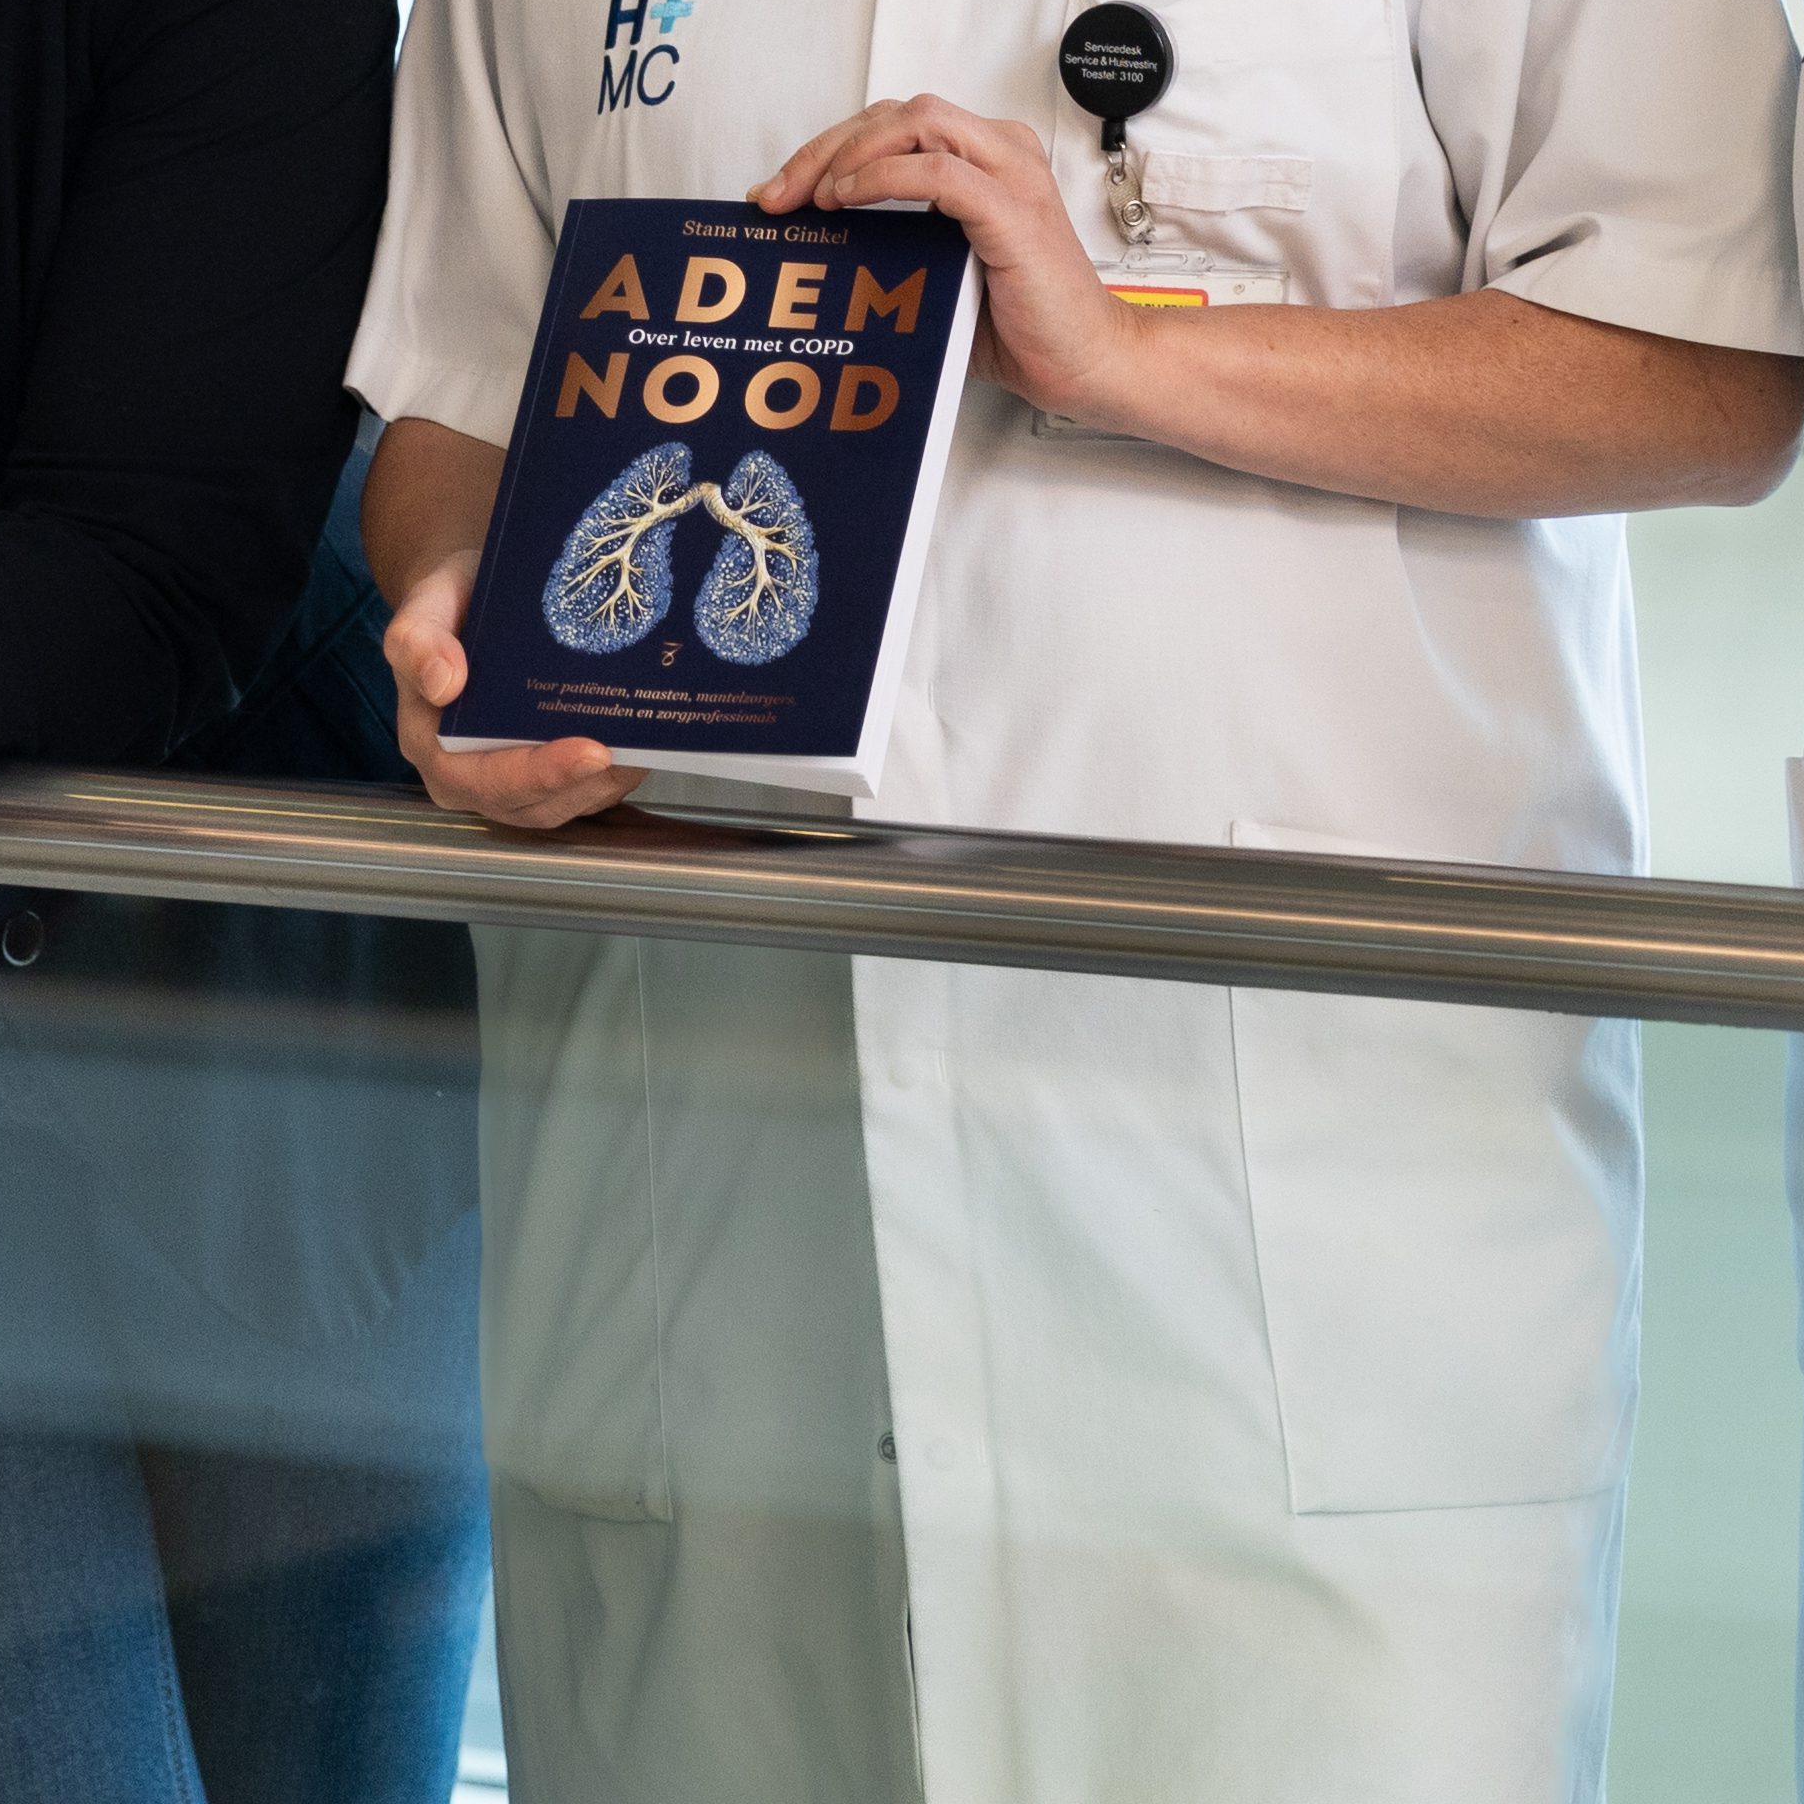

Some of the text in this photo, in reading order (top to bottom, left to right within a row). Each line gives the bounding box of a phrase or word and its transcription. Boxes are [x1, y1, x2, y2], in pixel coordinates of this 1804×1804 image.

[1065, 54, 1099, 65] Service
[1100, 56, 1107, 66] &
[1084, 41, 1142, 56] Servicedesk
[598, 44, 680, 115] MC
[1119, 71, 1144, 83] 3100
[683, 219, 849, 245] Stana van Ginkel
[579, 253, 928, 334] ADEM
[628, 328, 854, 356] Over leven met COPD
[555, 350, 900, 432] NOOD
[526, 678, 558, 692] Voor
[559, 681, 631, 700] patiënten,
[634, 687, 693, 703] naasten,
[537, 699, 778, 725] nabestaanden en zorgprofessionals
